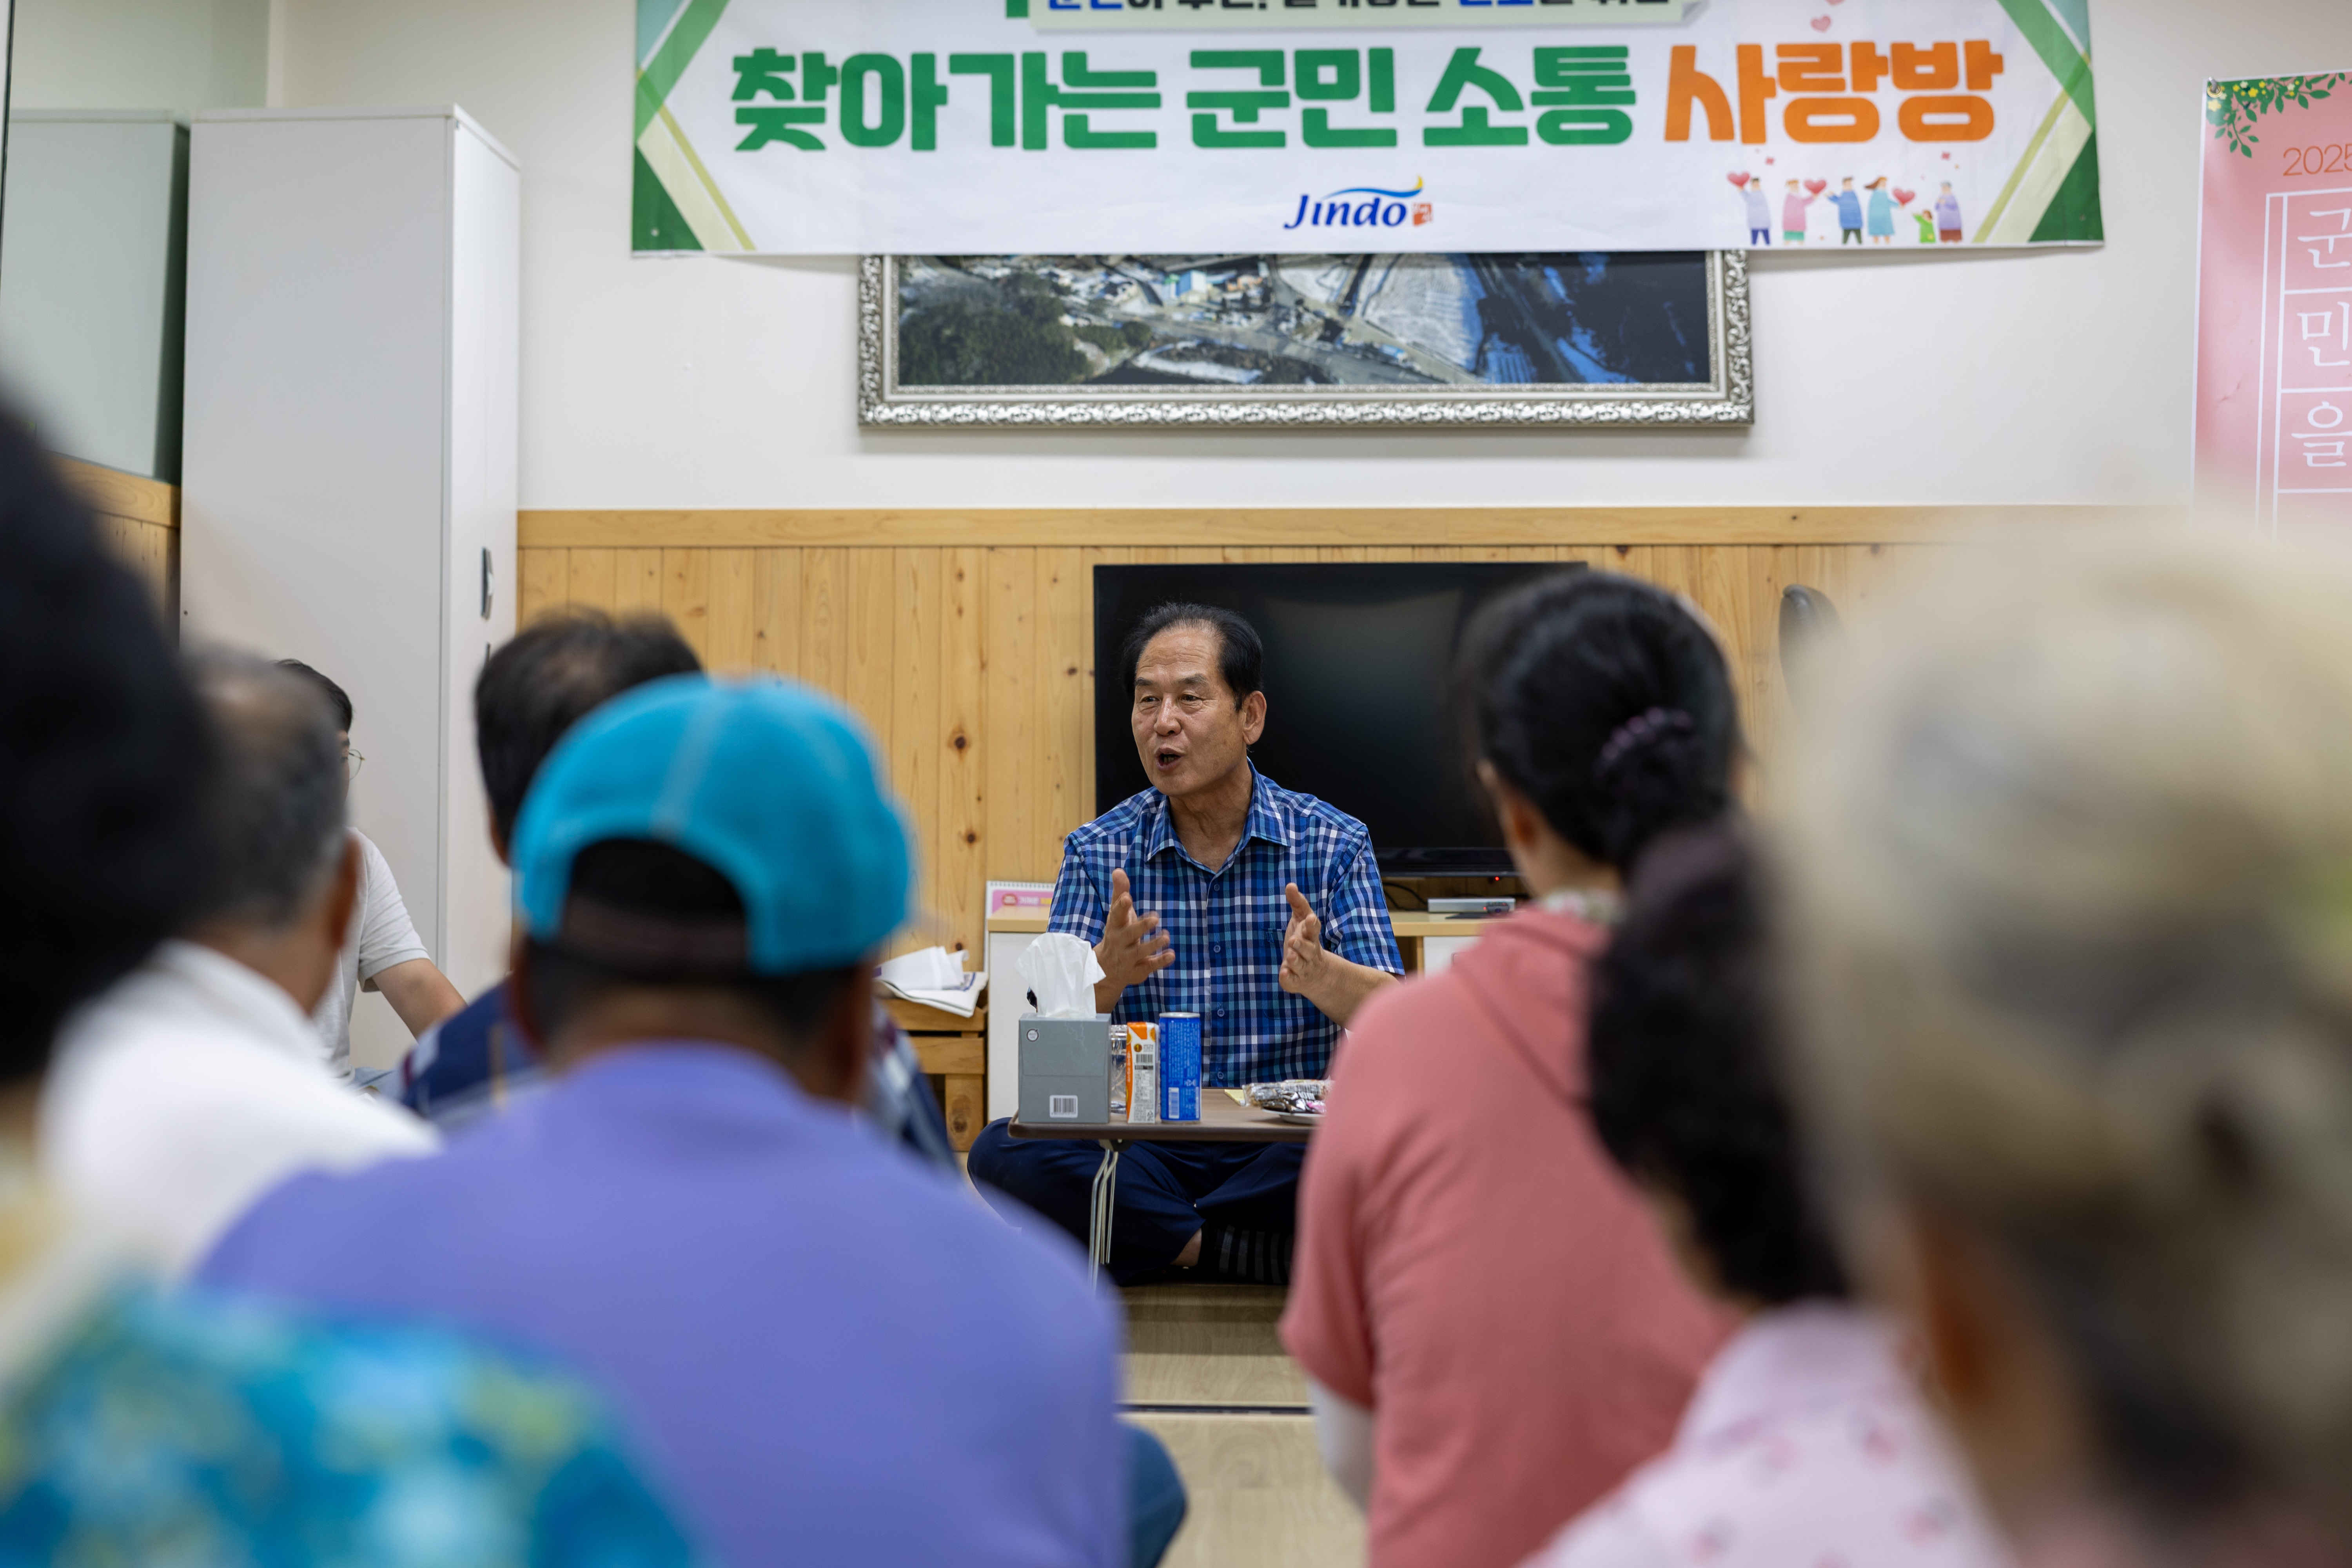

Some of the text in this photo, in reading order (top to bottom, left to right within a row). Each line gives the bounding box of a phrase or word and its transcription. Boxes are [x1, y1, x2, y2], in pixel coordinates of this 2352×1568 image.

[731, 40, 2004, 151] 찾아가는 군민 소통 사랑방
[1283, 194, 1406, 229] Jindo
